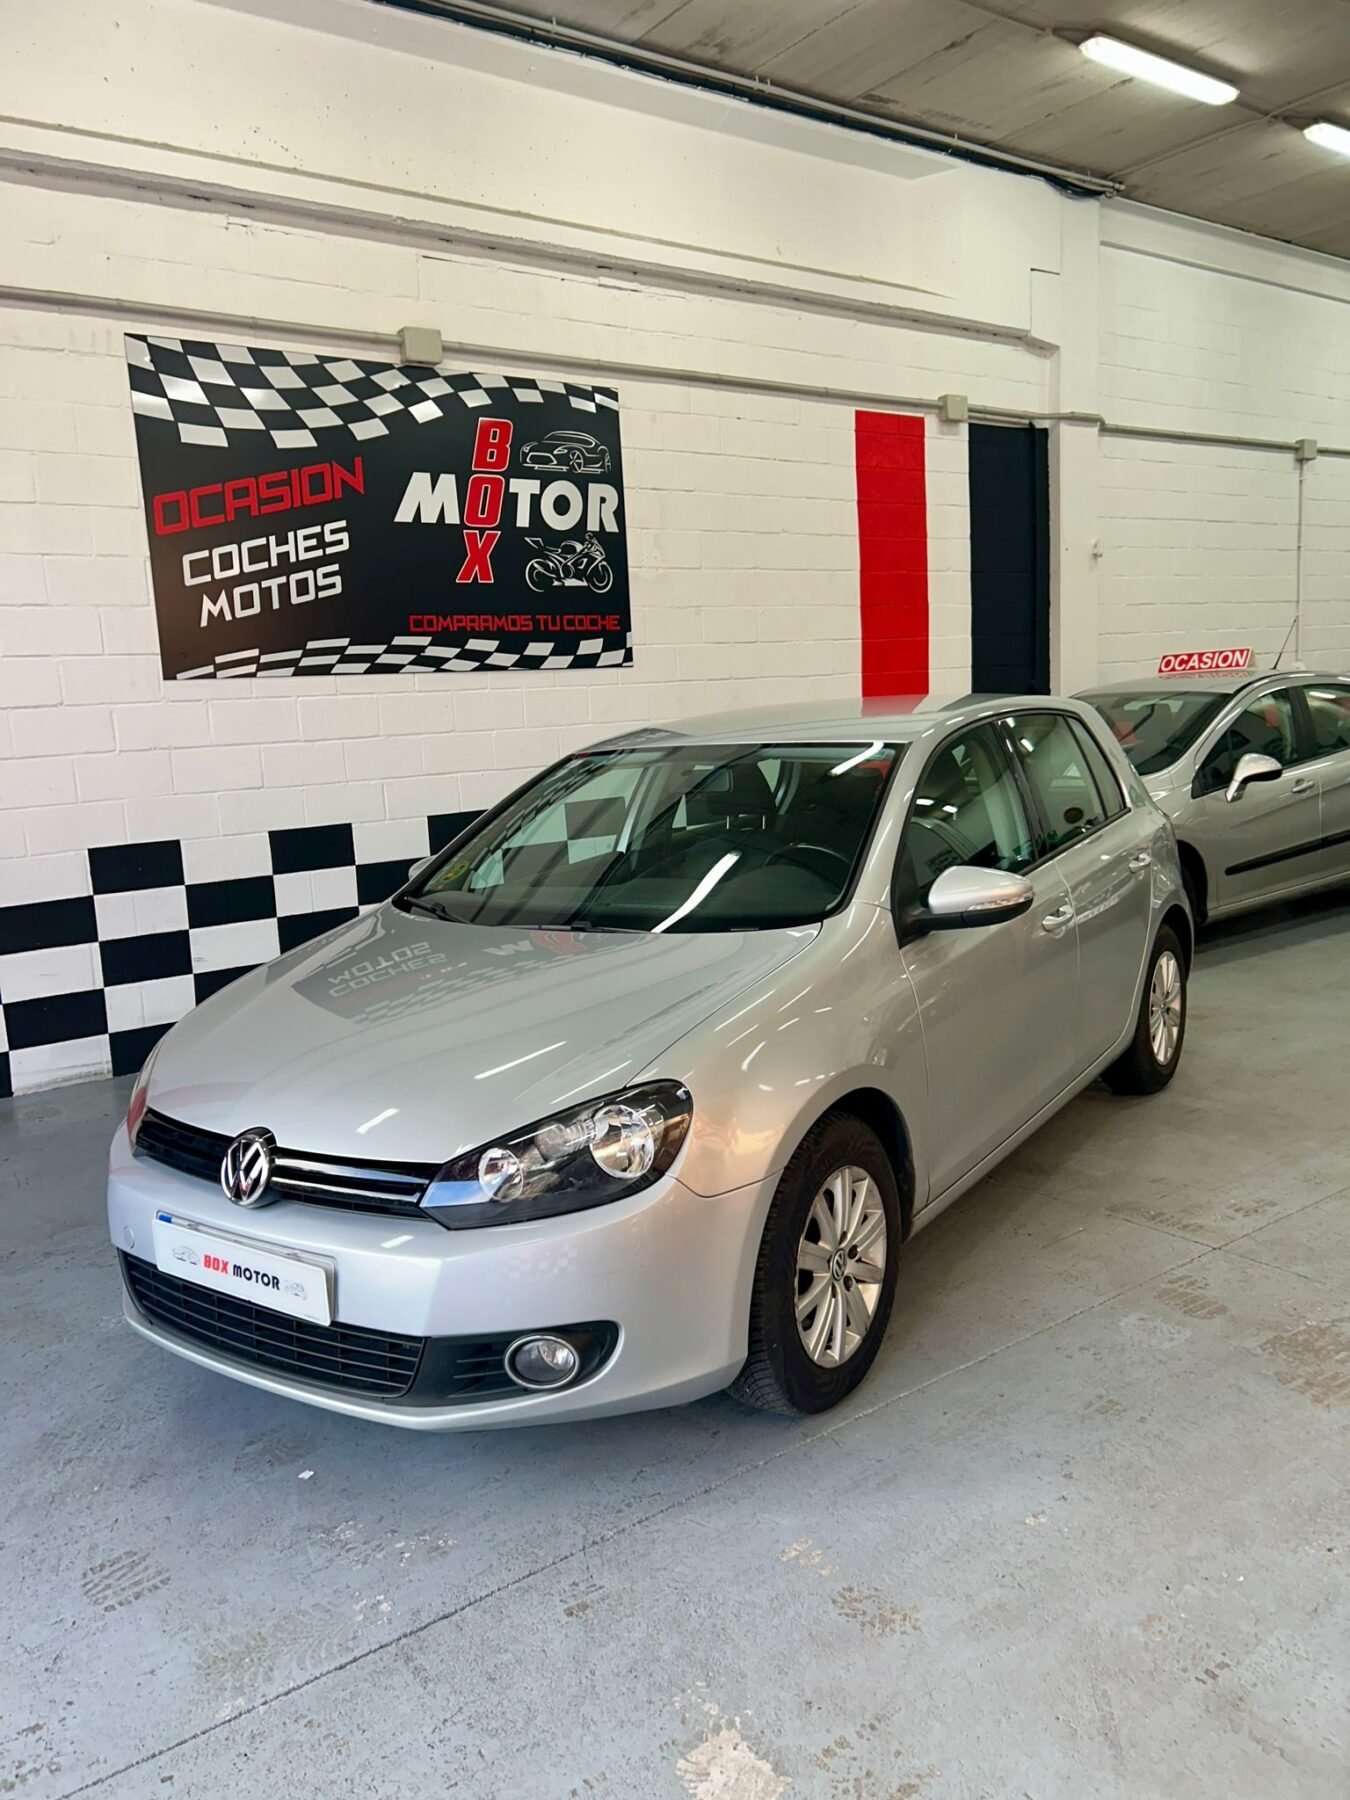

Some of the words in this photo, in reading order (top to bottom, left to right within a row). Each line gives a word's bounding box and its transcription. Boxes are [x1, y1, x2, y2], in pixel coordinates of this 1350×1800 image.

[153, 456, 364, 536] OCASION
[394, 472, 619, 533] MOTOR
[456, 417, 513, 583] BOX
[182, 520, 350, 587] COCHES
[200, 563, 342, 628] MOTOS
[409, 615, 532, 632] COMPRAMOS
[536, 615, 560, 631] TU
[563, 615, 621, 631] COCHE
[1160, 650, 1248, 671] OCASION
[204, 1254, 229, 1274] BOX
